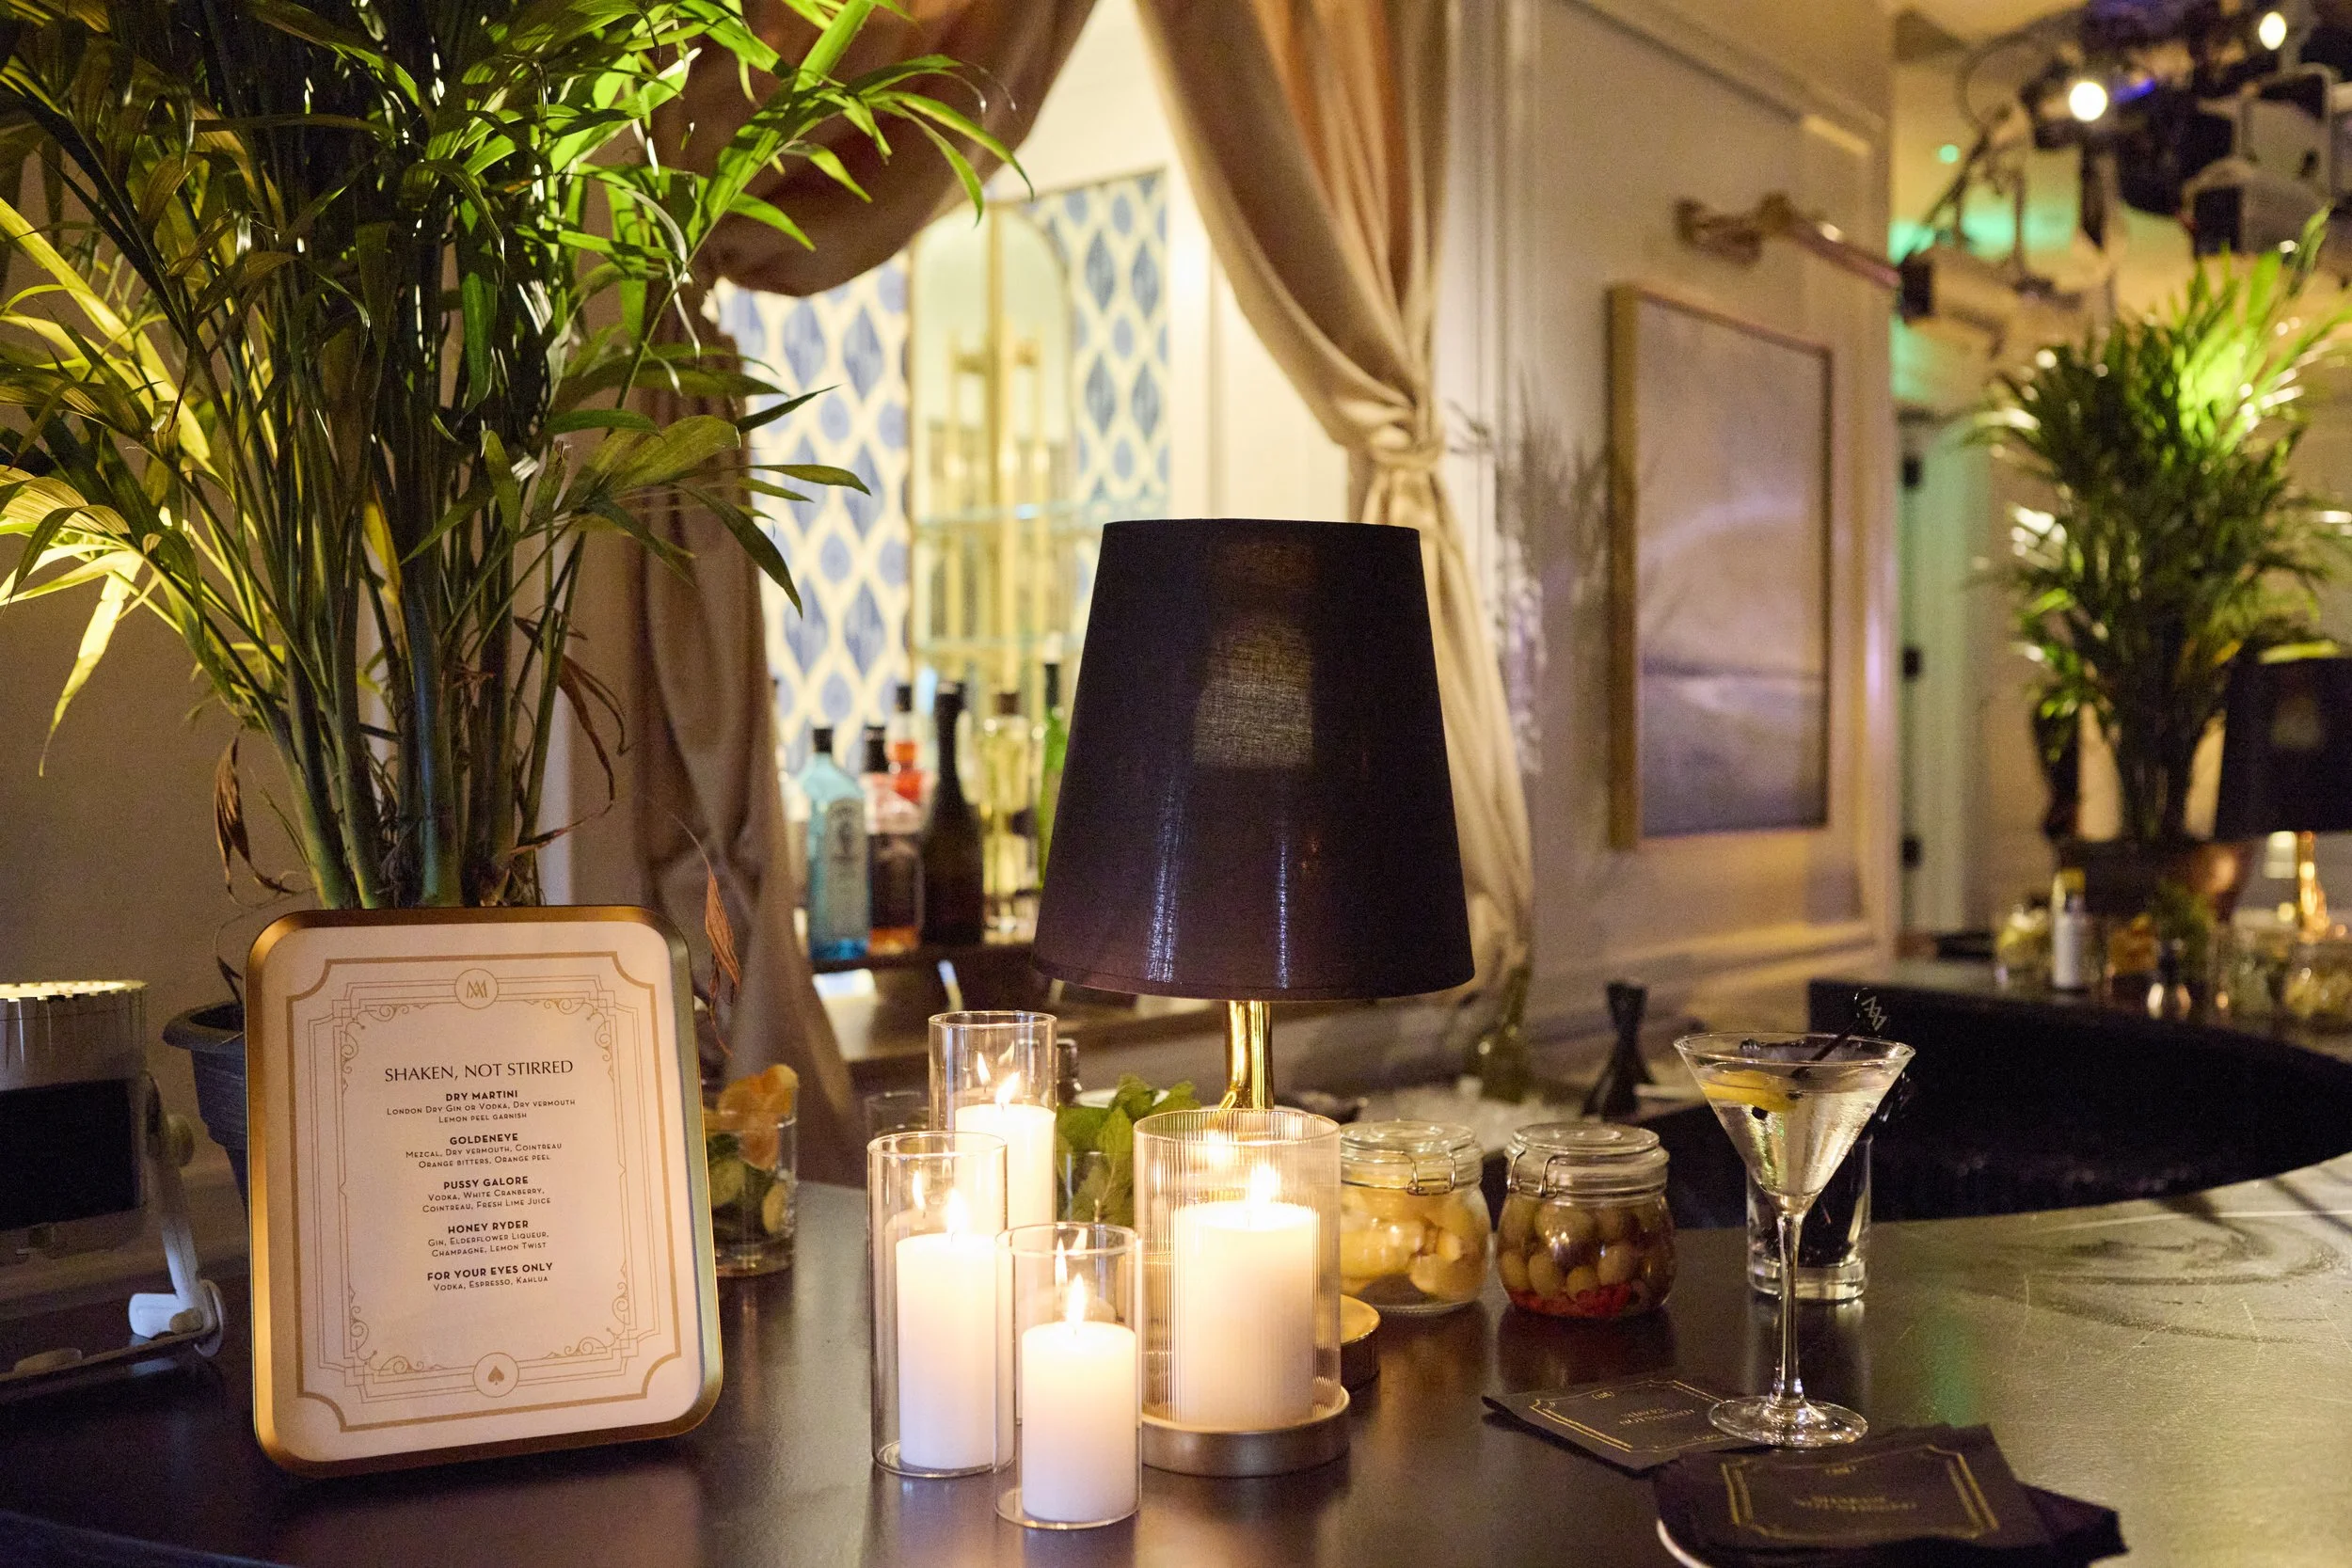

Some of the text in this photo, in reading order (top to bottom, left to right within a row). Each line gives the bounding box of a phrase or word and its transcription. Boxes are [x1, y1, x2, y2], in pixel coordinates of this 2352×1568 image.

[385, 1060, 573, 1083] SHAKEN, NOT STIRRED
[446, 1089, 517, 1101] DRY MARTINI
[425, 1105, 443, 1114] DRY
[513, 1101, 530, 1109] DRY
[449, 1132, 518, 1146] GOLDENEYE
[515, 1143, 562, 1151] COINTREAU
[418, 1160, 453, 1168] ORANGE
[494, 1155, 529, 1164] ORANGE
[443, 1176, 529, 1190] PUSSY GALORE
[448, 1220, 529, 1234] HONEY RYDER
[450, 1234, 508, 1245] ELDERFLOWER
[427, 1262, 553, 1281] FOR YOUR EYES ONLY
